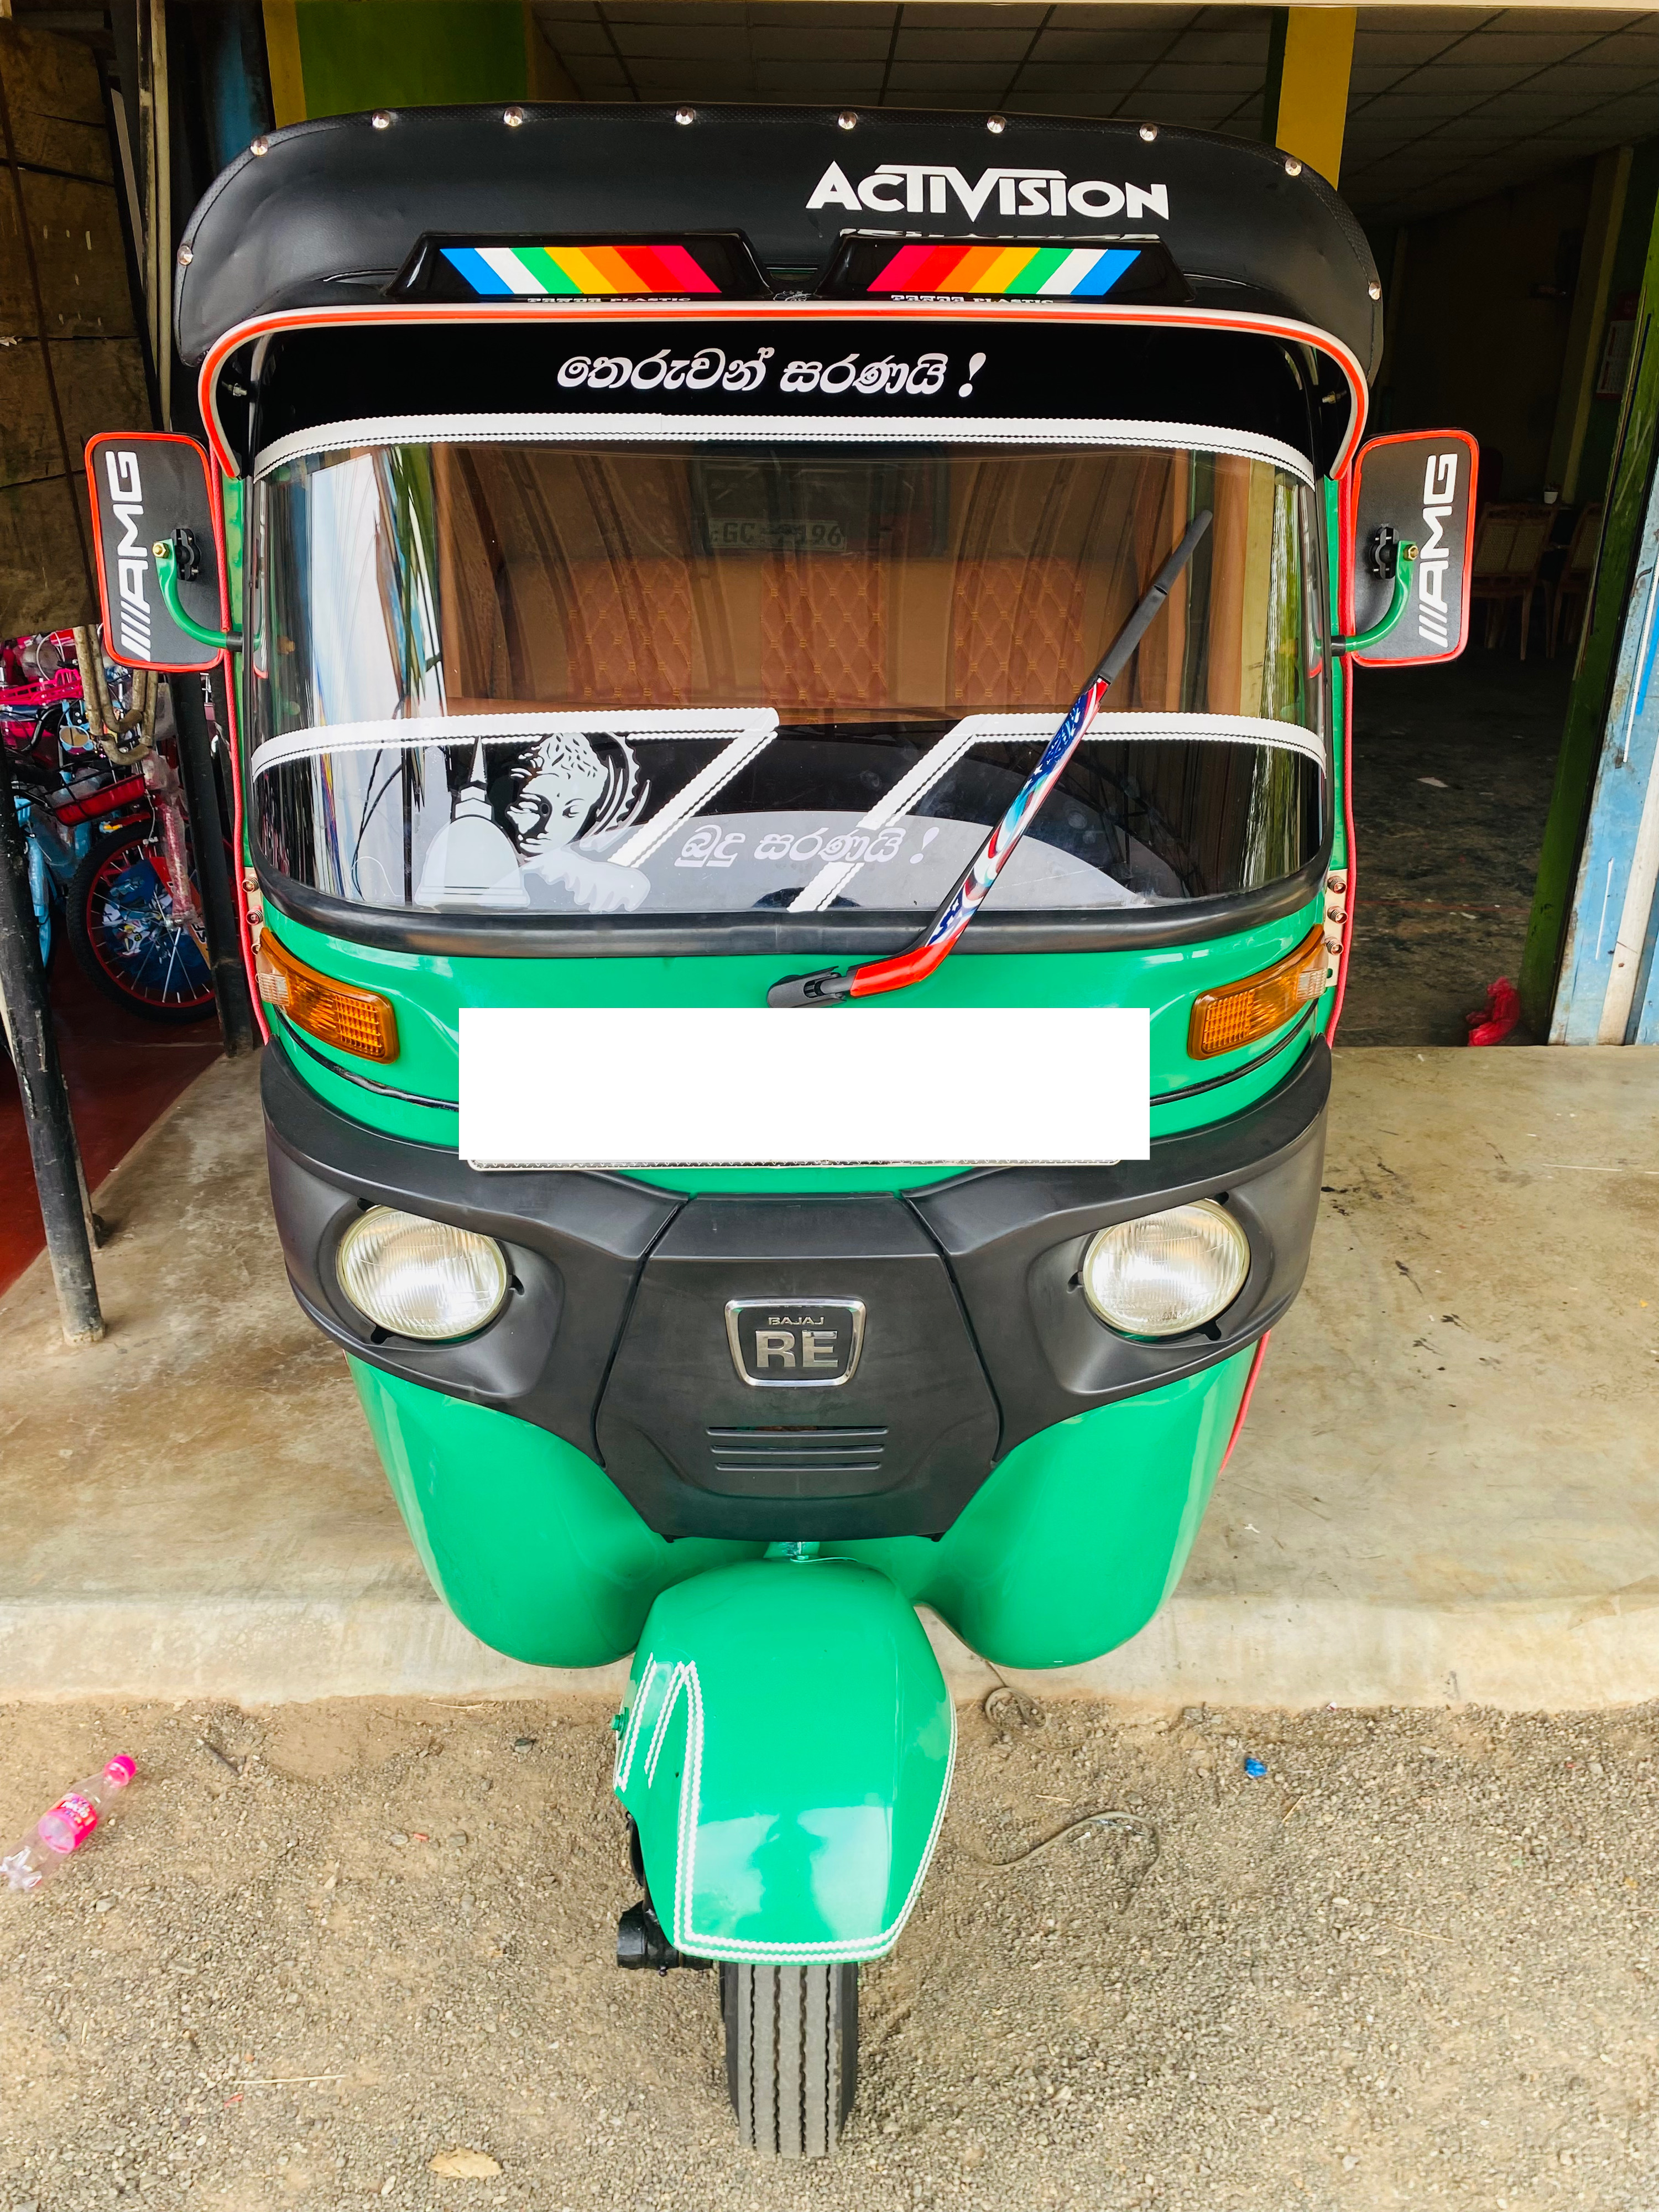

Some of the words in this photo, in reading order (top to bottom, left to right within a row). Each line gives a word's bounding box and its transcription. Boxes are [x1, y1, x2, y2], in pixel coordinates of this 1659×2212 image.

[806, 161, 1168, 222] ACTIVISION
[557, 347, 774, 390] තෙරුවන්
[780, 353, 948, 394] සරණයි
[754, 827, 906, 863] සරණයි
[768, 1317, 824, 1325] BAJAJ
[755, 1330, 838, 1367] RE
